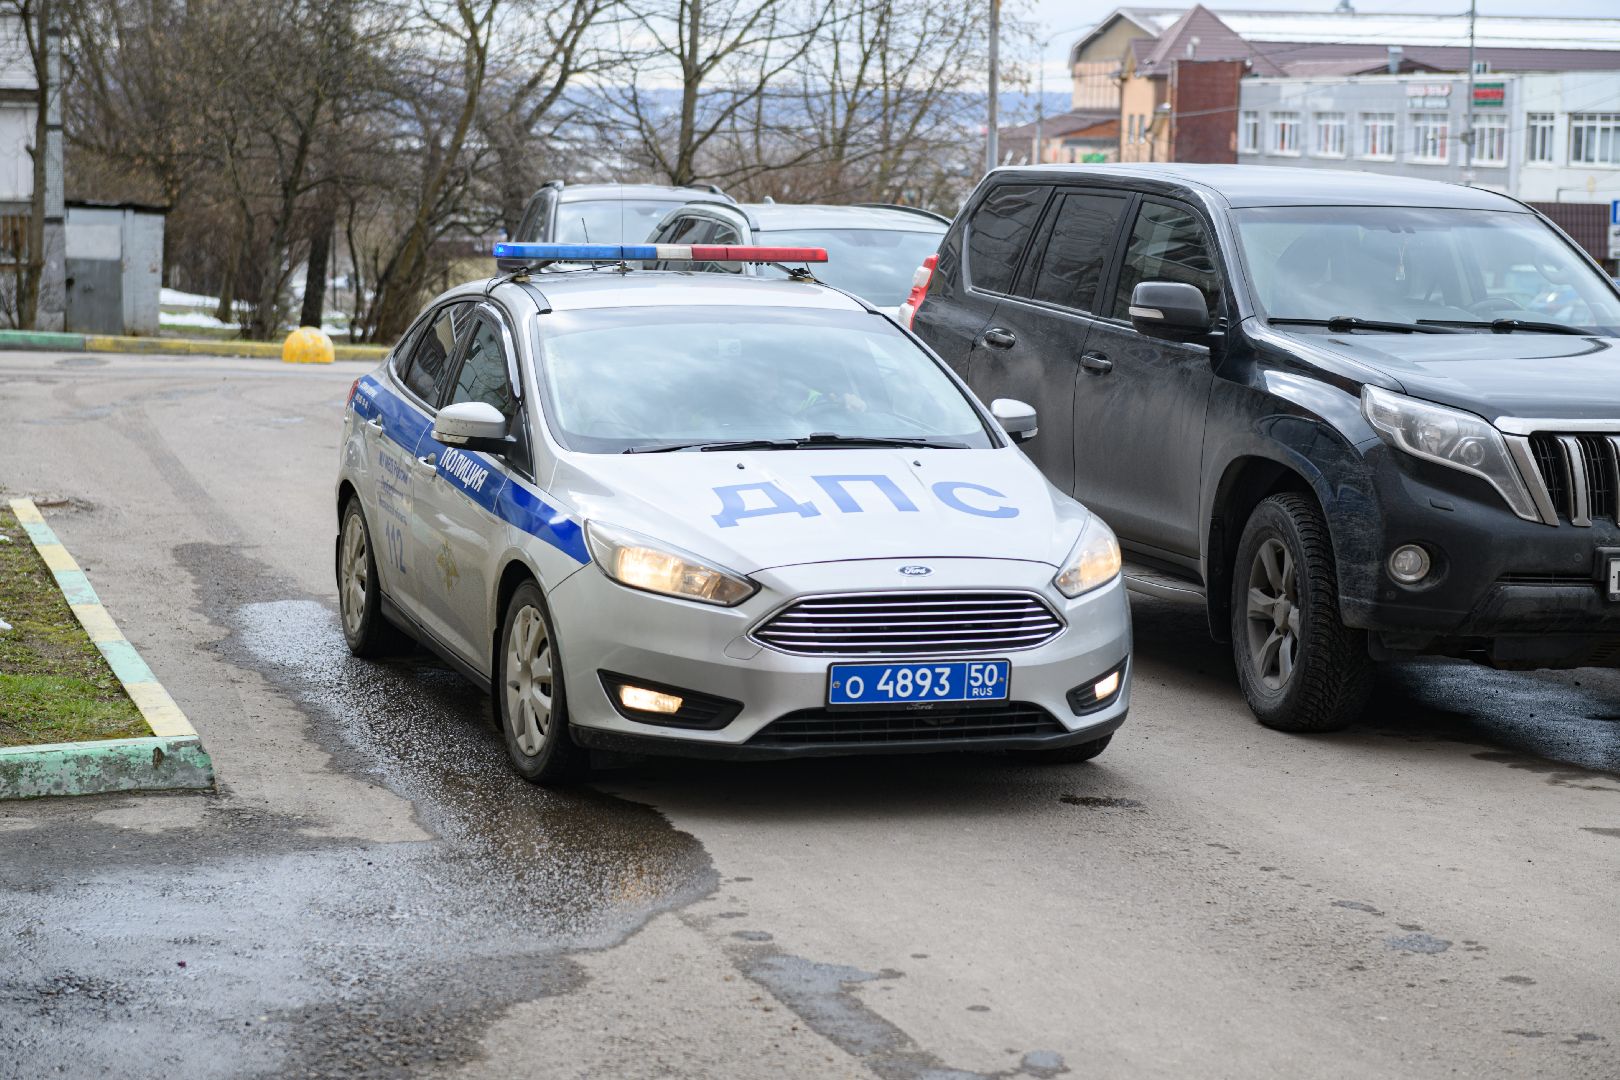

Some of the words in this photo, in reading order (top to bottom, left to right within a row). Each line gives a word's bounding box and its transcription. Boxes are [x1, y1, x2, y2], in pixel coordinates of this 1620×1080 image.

[439, 446, 489, 493] ПОЛИЦИЯ
[711, 474, 1020, 528] ДПС
[385, 519, 407, 575] 112
[876, 667, 951, 698] 4893
[969, 664, 999, 687] 50
[972, 686, 993, 697] RUS
